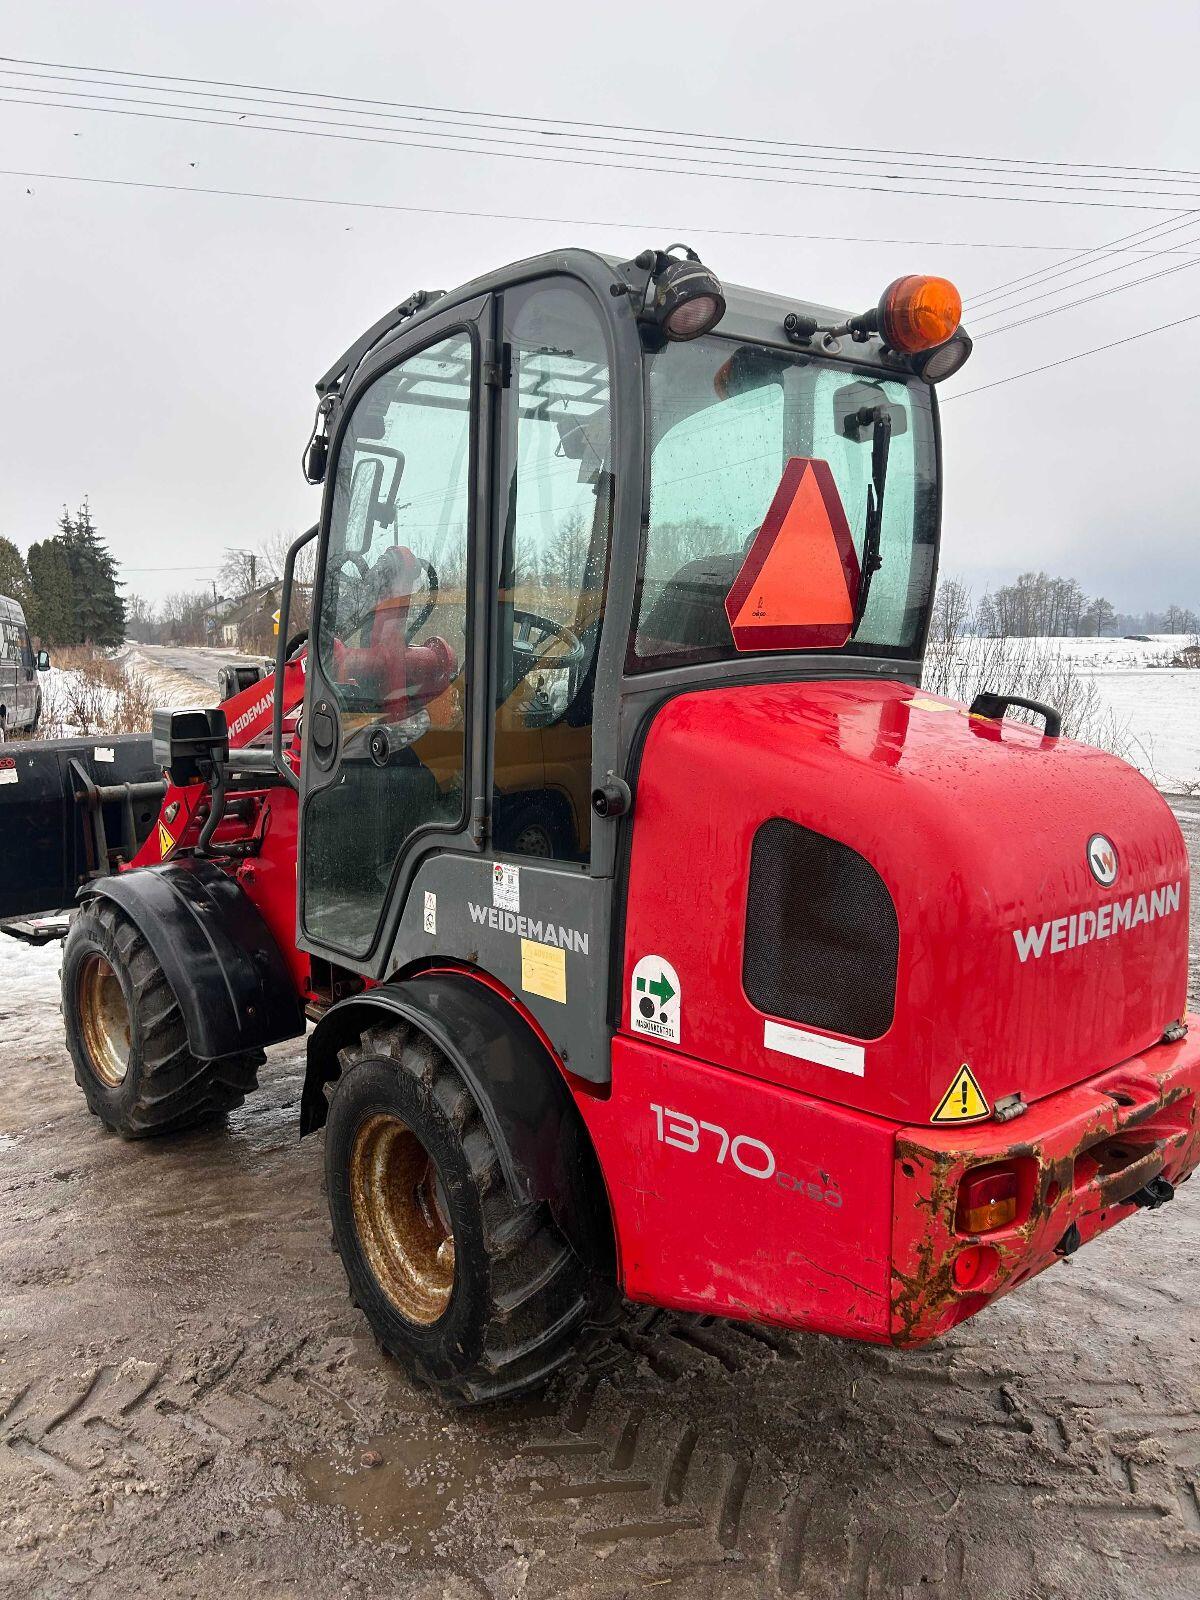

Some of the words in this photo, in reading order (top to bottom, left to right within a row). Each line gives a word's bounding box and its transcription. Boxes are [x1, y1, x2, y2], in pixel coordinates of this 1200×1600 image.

[227, 689, 275, 739] WEIDEMAN
[468, 901, 589, 955] WEIDEMANN
[1013, 881, 1181, 963] WEIDEMANN
[650, 1102, 776, 1179] 1370
